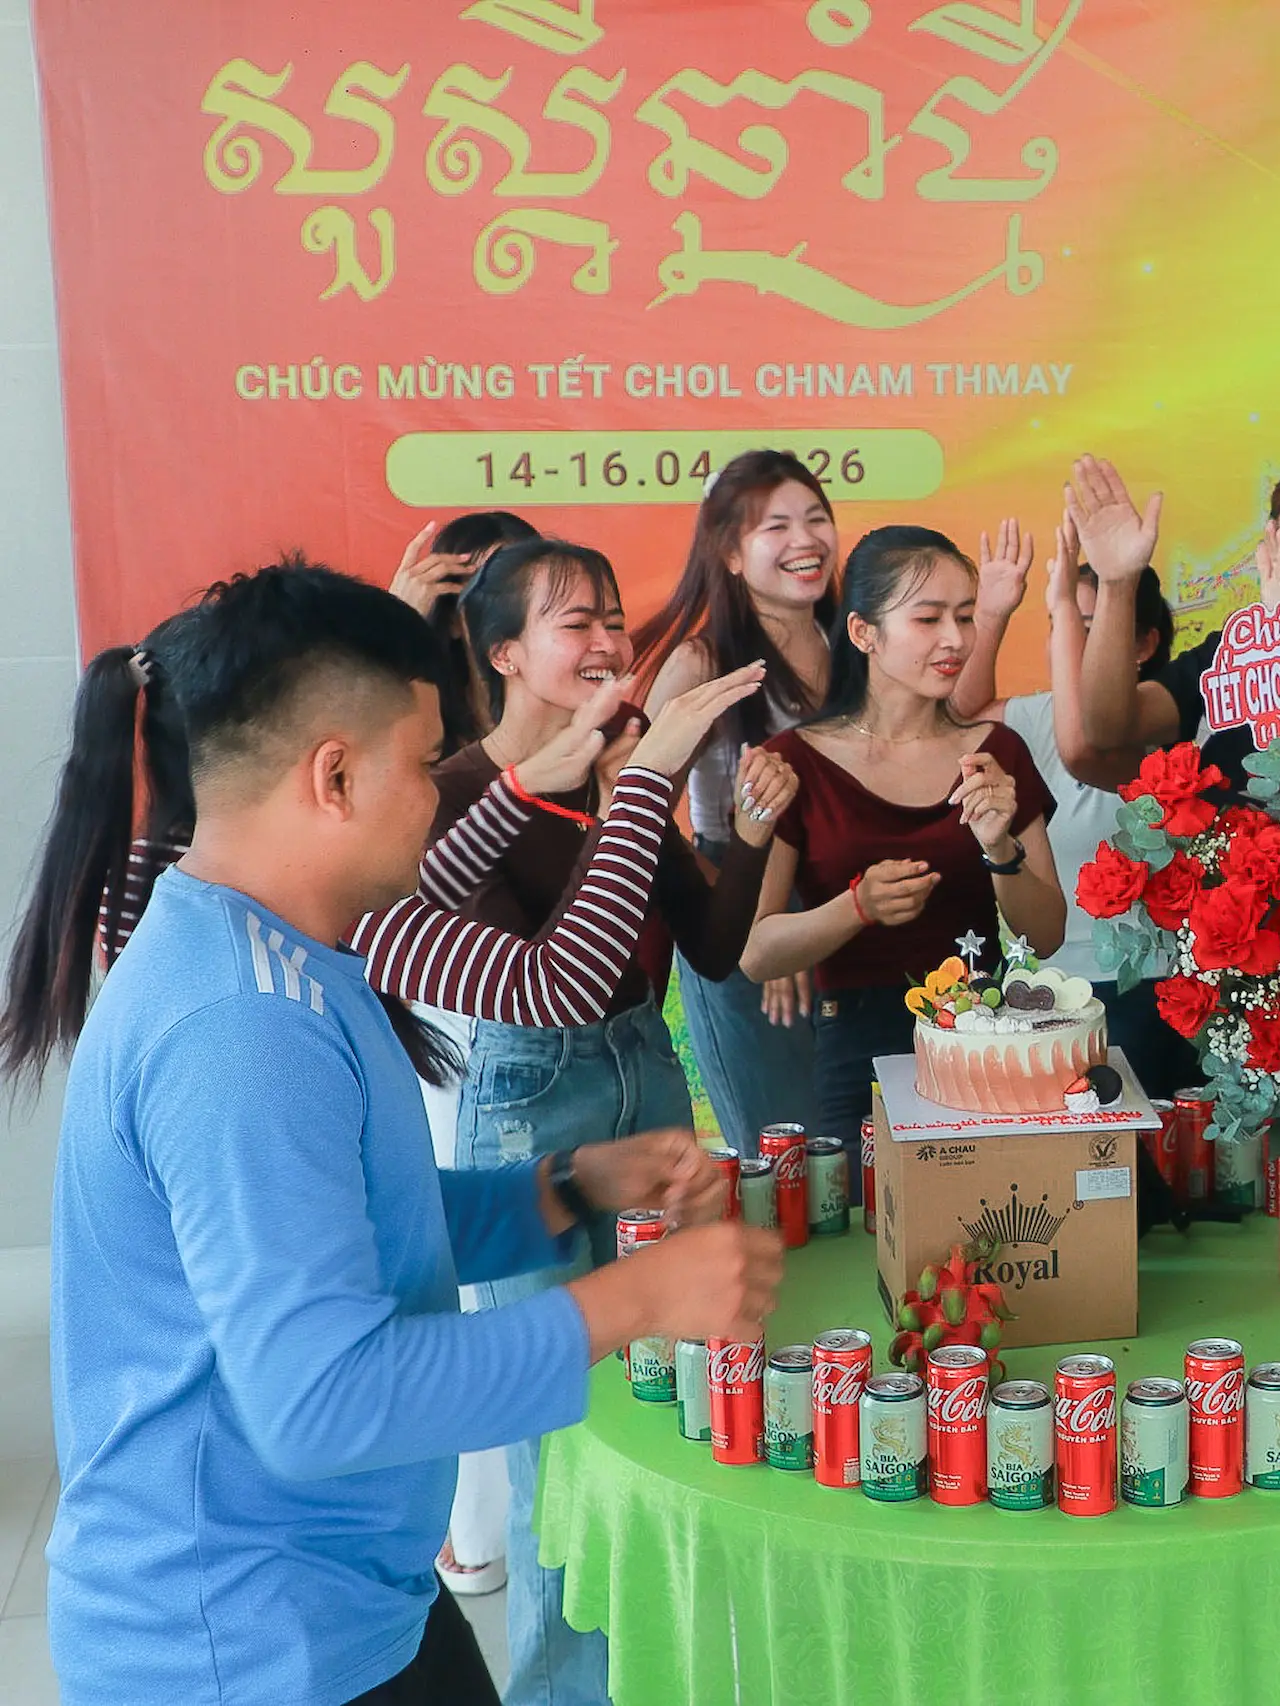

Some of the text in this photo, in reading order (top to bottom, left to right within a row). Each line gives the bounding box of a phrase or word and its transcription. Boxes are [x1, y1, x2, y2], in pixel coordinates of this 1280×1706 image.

[235, 354, 1074, 400] CHÚC MỪNG TẾT CHOL CHNAM THMAY
[476, 448, 866, 489] 14-16.0426
[1208, 650, 1242, 725] TẾT
[949, 1145, 976, 1154] CHAU
[973, 1249, 1061, 1290] Royal
[865, 1459, 917, 1476] SAIGON
[880, 1455, 898, 1463] BIA
[1006, 1463, 1023, 1471] BIA
[991, 1466, 1043, 1484] SAIGON
